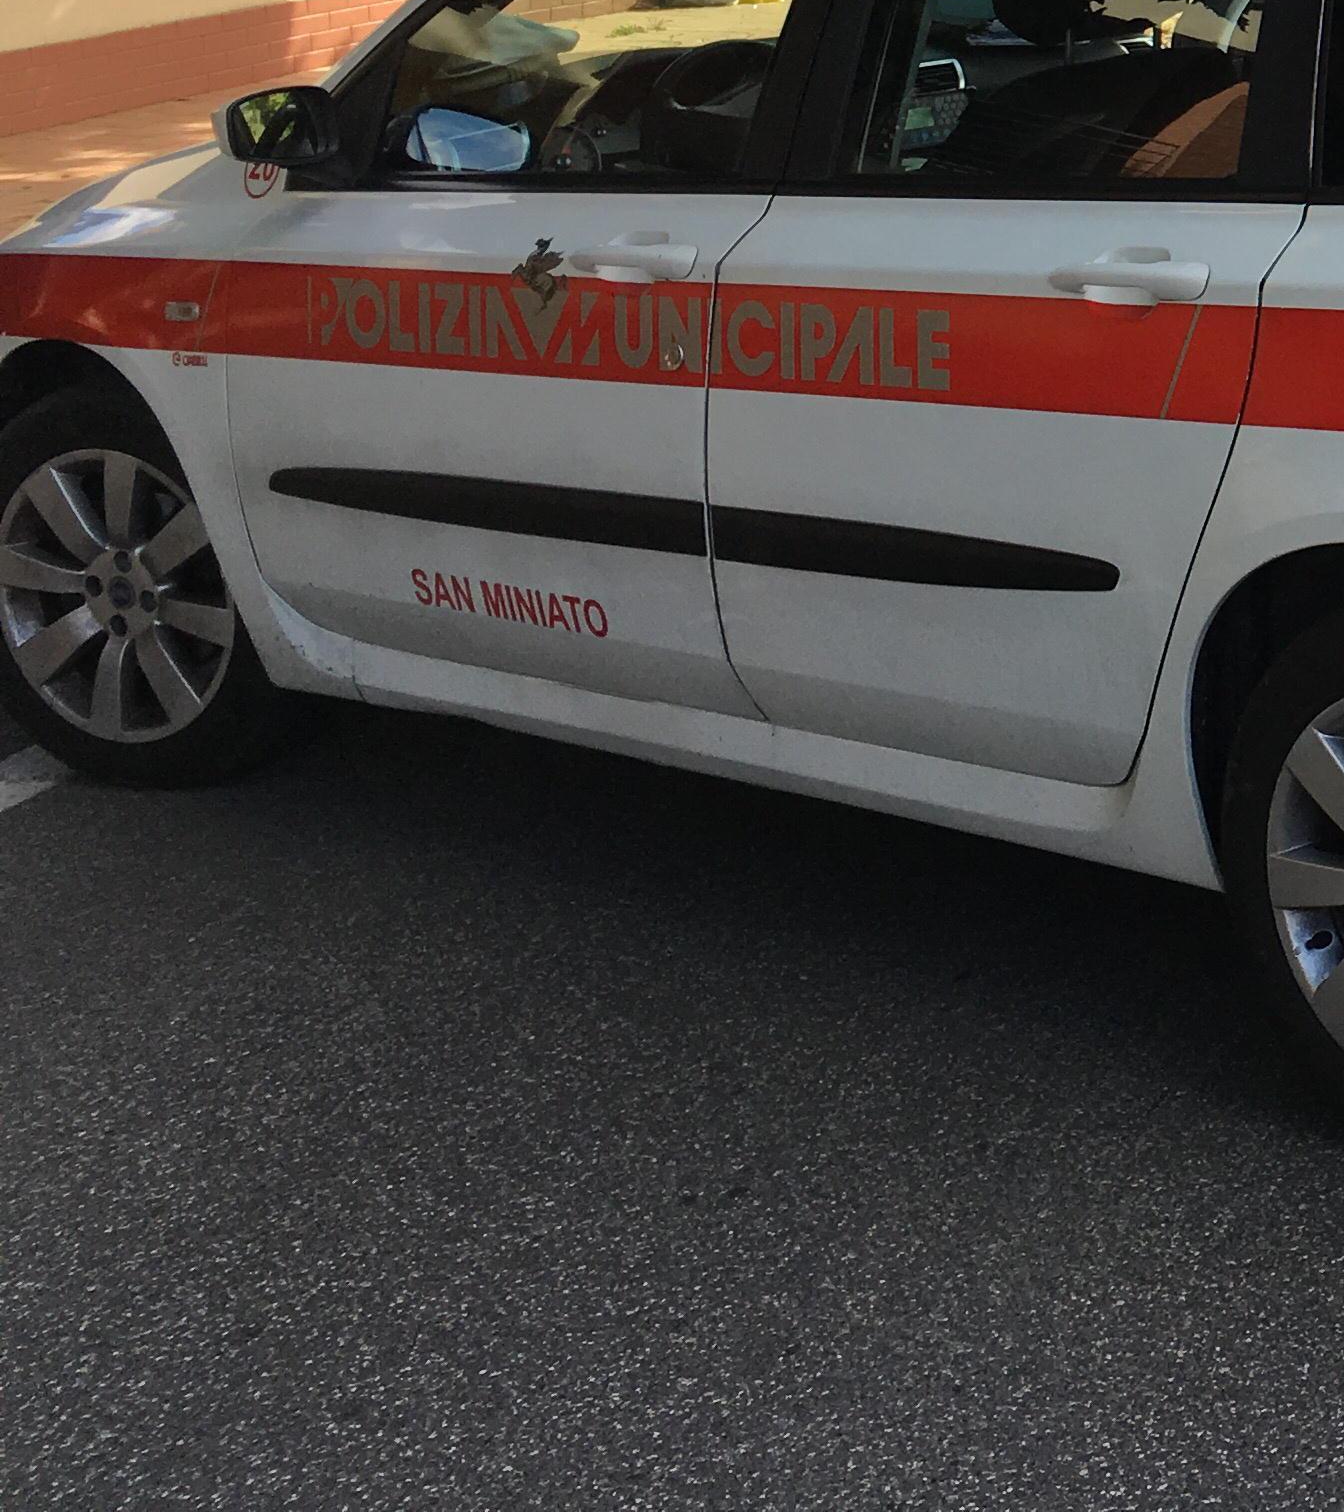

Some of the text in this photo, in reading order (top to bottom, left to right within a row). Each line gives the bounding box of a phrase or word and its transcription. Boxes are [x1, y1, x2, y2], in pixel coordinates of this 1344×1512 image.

[307, 276, 950, 391] POLIZIA MUNICIPALE
[411, 568, 608, 638] SAN MINIATO
